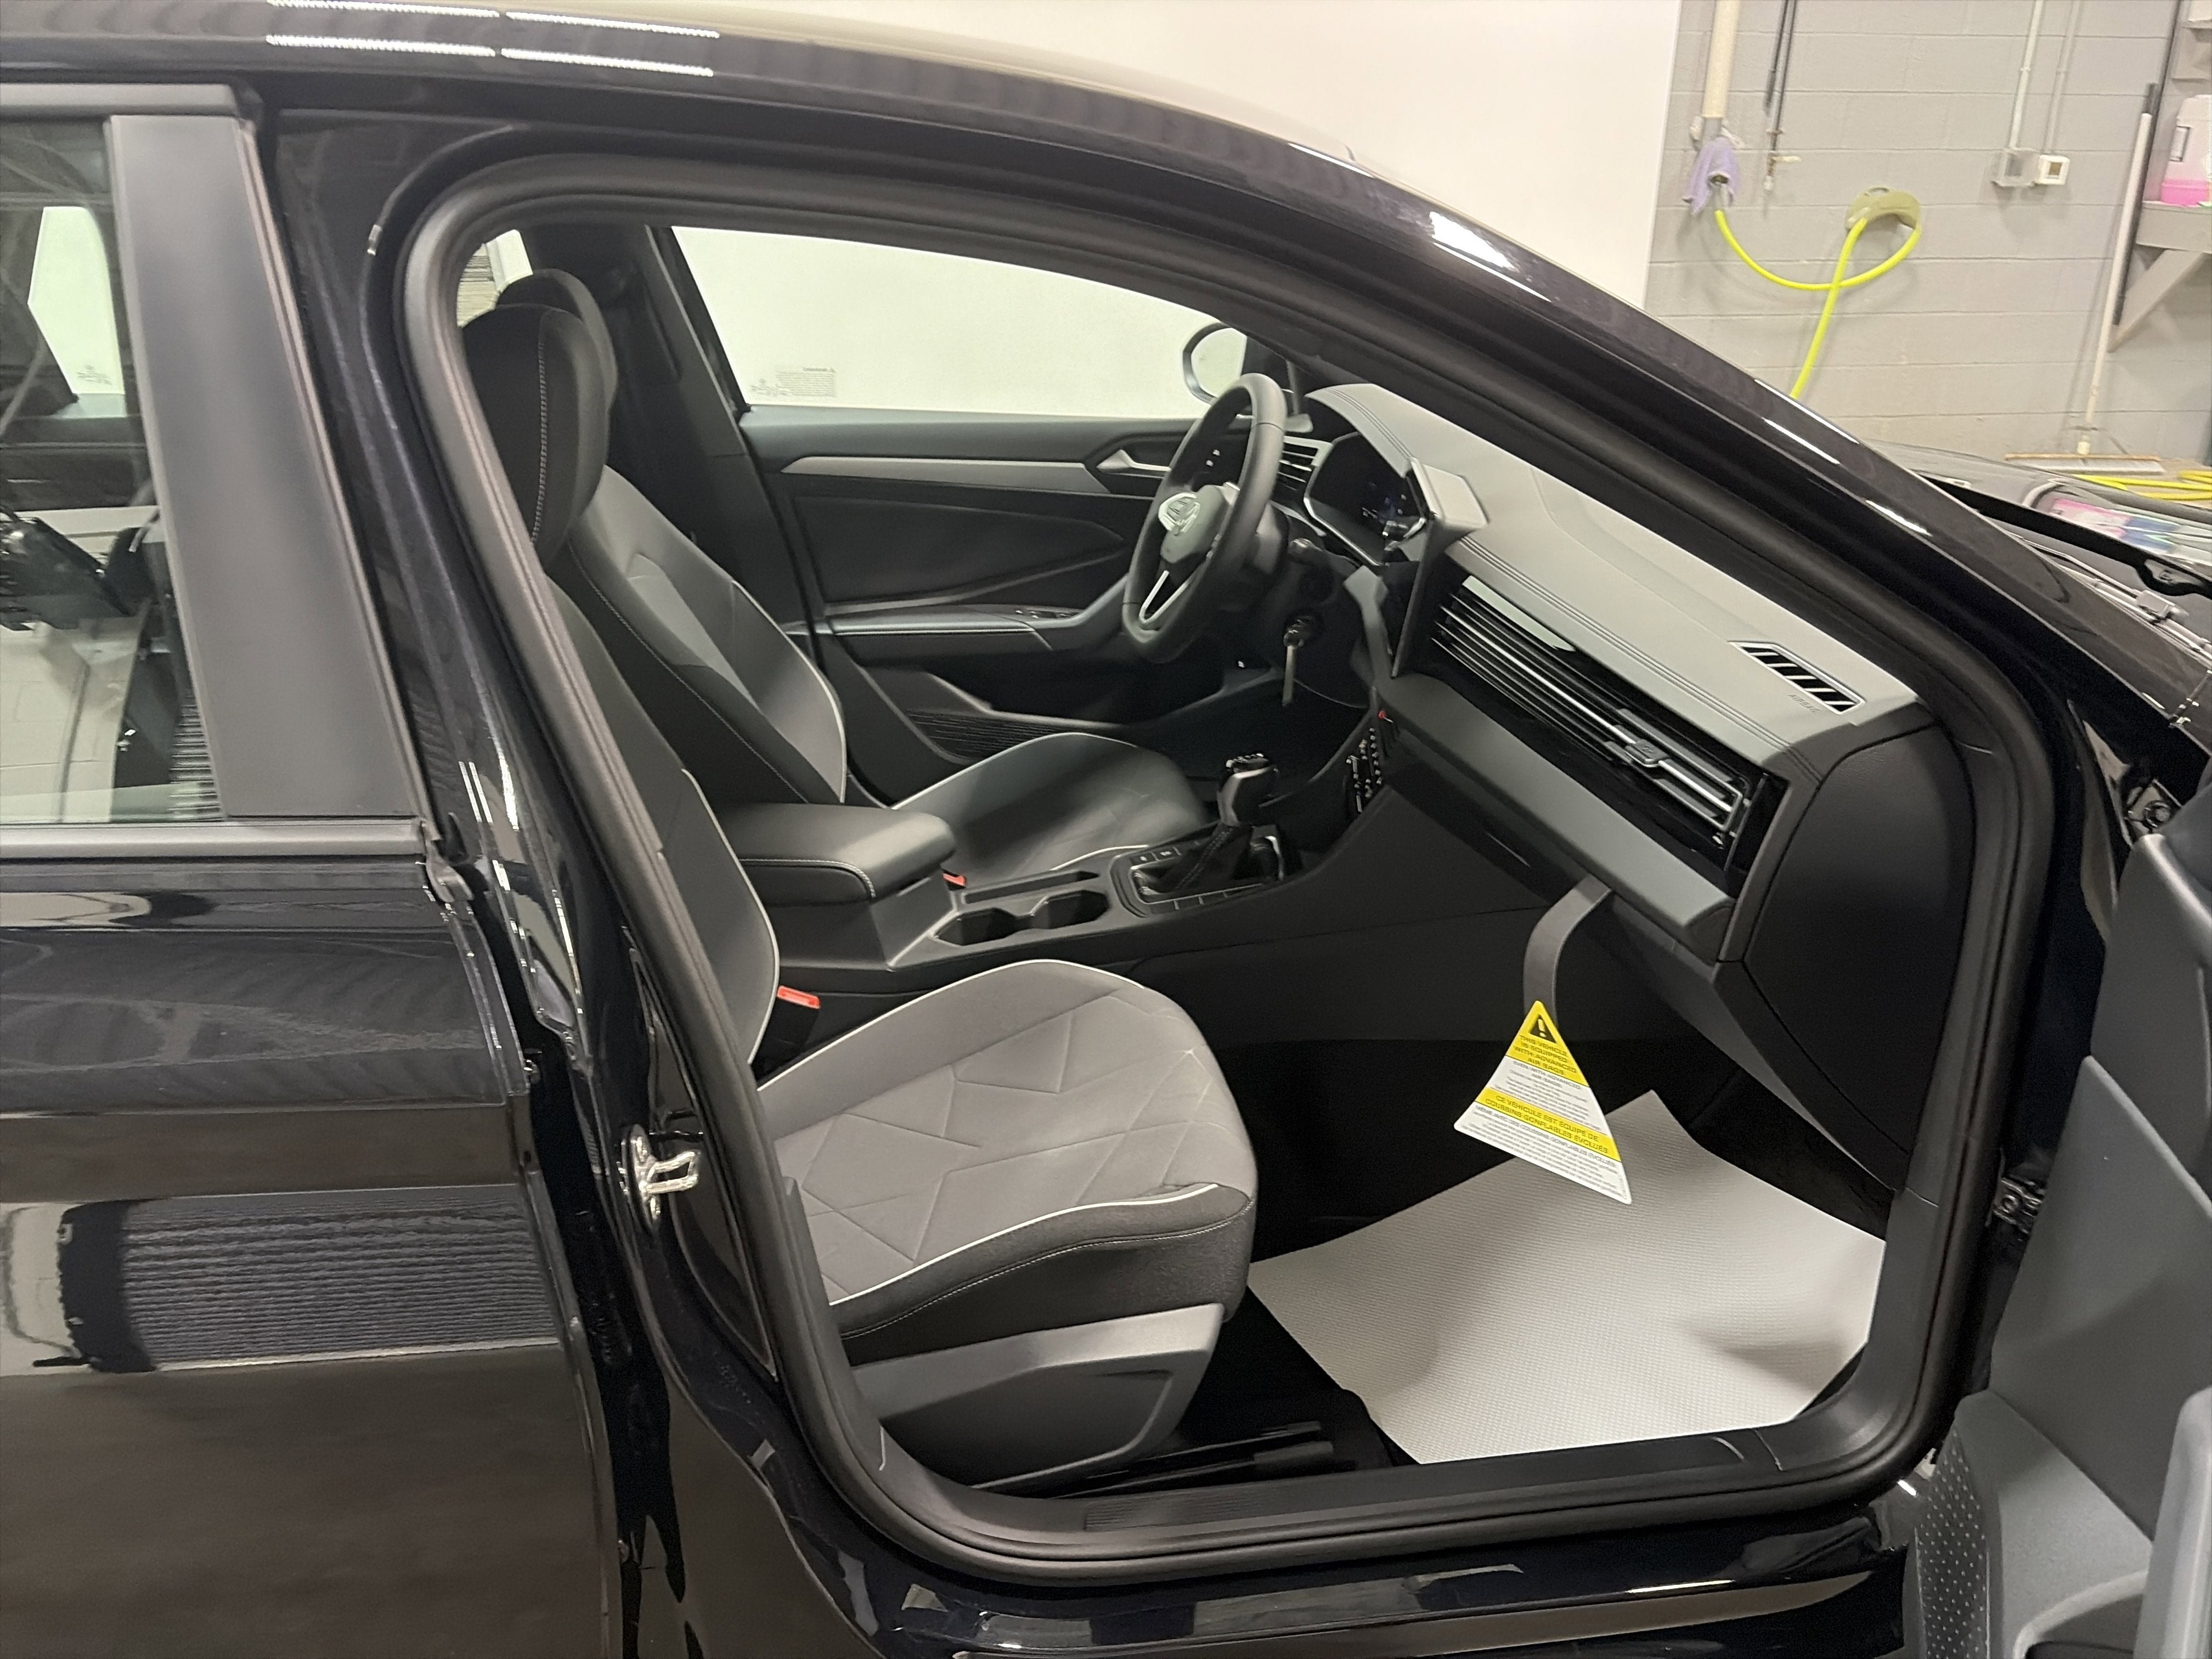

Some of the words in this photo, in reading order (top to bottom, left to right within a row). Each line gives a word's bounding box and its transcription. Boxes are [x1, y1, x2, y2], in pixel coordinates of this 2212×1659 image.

[1788, 695, 1820, 713] AIRBAG
[1519, 1035, 1536, 1045] THIS
[1538, 1042, 1568, 1057] VEHICLE
[1530, 1045, 1567, 1063] EQUIPPED
[1527, 1057, 1539, 1065] AIR
[1535, 1053, 1576, 1073] ADVANCED
[1496, 1095, 1505, 1103] CE
[1543, 1114, 1558, 1125] EST
[1588, 1133, 1599, 1142] DE
[1523, 1114, 1572, 1138] GONFLABLES
